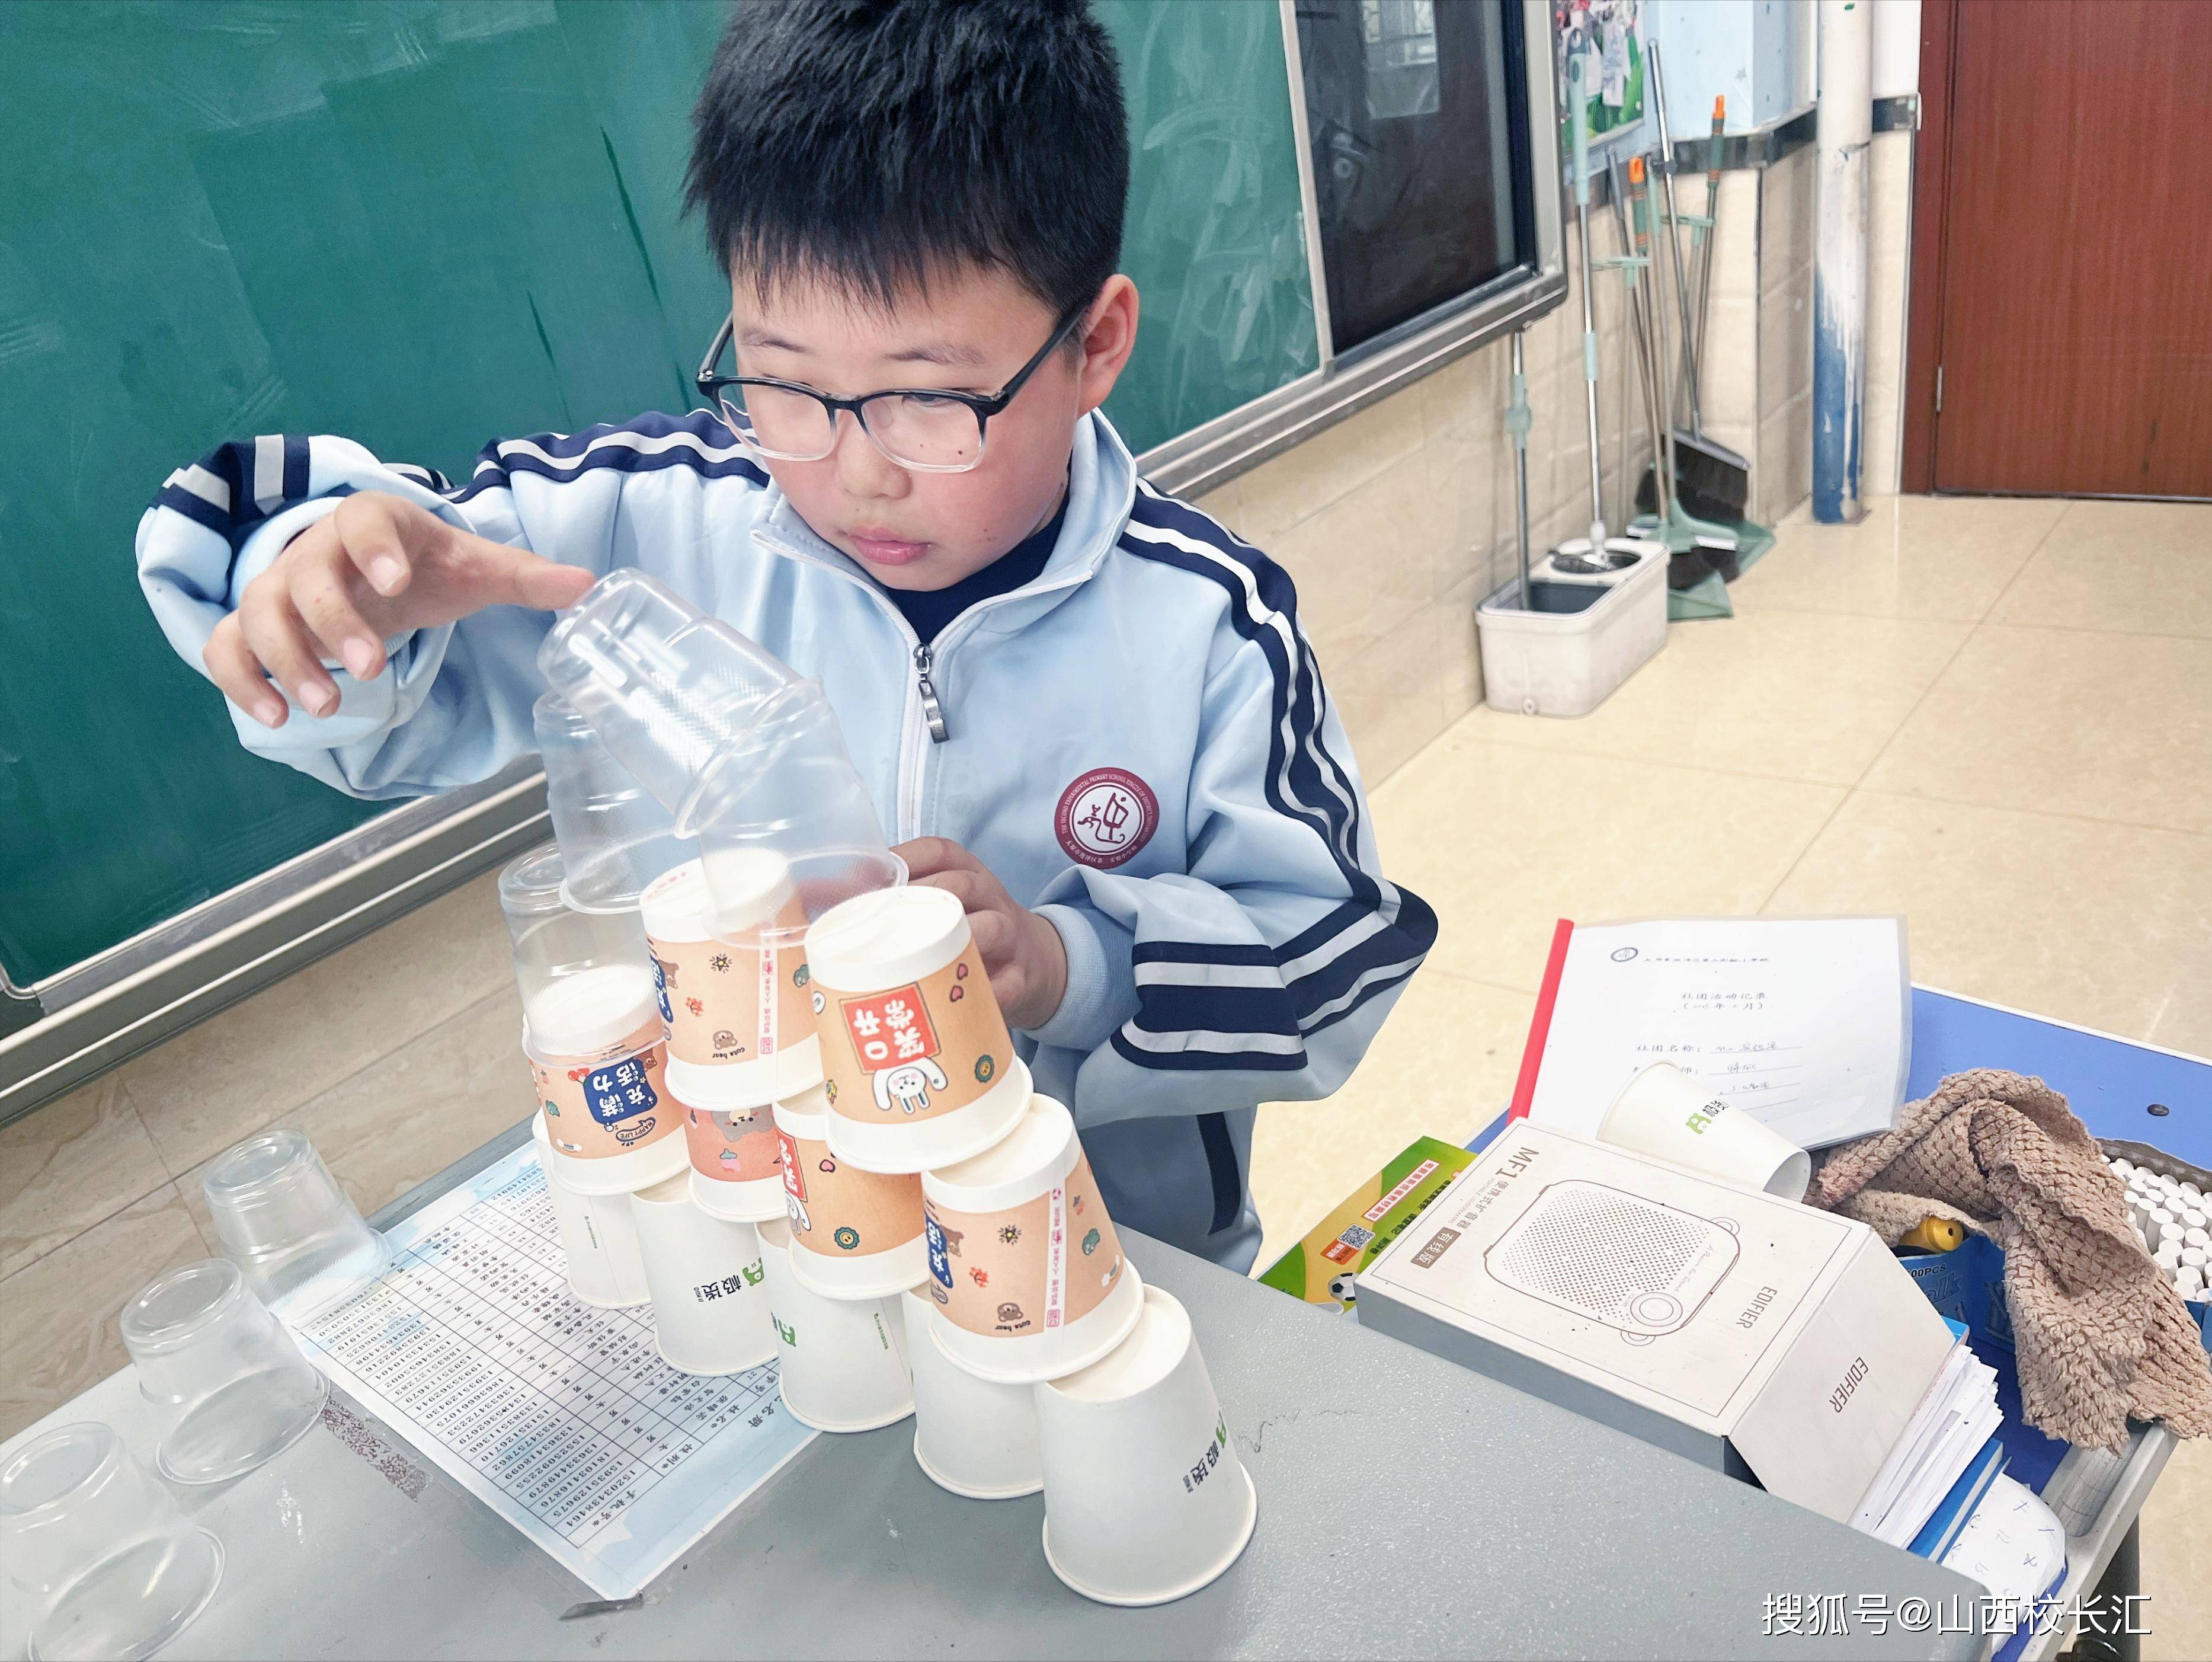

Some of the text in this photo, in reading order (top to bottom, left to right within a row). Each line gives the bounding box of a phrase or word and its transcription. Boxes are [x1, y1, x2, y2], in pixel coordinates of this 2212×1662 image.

[729, 1047, 745, 1059] cute
[619, 1120, 652, 1139] HAPPY LIFE
[1496, 1147, 1539, 1178] MF1
[1456, 1180, 1509, 1229] 便携式扩音器
[1417, 1232, 1454, 1264] 有线版
[702, 1274, 742, 1302] 极货
[1909, 1264, 1947, 1278] 00PCS
[441, 1298, 454, 1306] 女
[462, 1311, 473, 1319] 女
[1736, 1286, 1777, 1328] EDIFIER
[356, 1320, 420, 1364] 13934634498
[482, 1325, 494, 1334] 女
[576, 1321, 603, 1341] 任天一
[1014, 1320, 1031, 1331] cute
[366, 1327, 430, 1370] 13935892216
[376, 1334, 440, 1379] 15343510404
[385, 1341, 450, 1387] 13834655002
[525, 1354, 538, 1363] 女
[395, 1348, 460, 1395] 18835127283
[406, 1356, 470, 1402] 15935114679
[416, 1363, 481, 1410] 19935362944
[547, 1369, 560, 1378] 女
[746, 1371, 757, 1379] 27
[755, 1376, 775, 1392] 学号
[1829, 1356, 1869, 1413] EDIFIER
[426, 1371, 492, 1418] 13935129430
[437, 1379, 503, 1426] 18636661075
[447, 1386, 514, 1435] 13633472253
[593, 1399, 607, 1409] 女
[459, 1394, 525, 1443] 13485362679
[470, 1402, 537, 1452] 13383511366
[481, 1410, 548, 1461] 15135126710
[492, 1418, 560, 1470] 18334757862
[505, 1427, 572, 1479] 13363418099
[516, 1435, 584, 1488] 15525092255
[656, 1442, 671, 1453] 女
[1190, 1440, 1219, 1486] 极货
[529, 1443, 597, 1497] 13633449879
[541, 1452, 609, 1507] 18103416876
[553, 1461, 622, 1516] 15935129675
[566, 1470, 635, 1526] 15203438464
